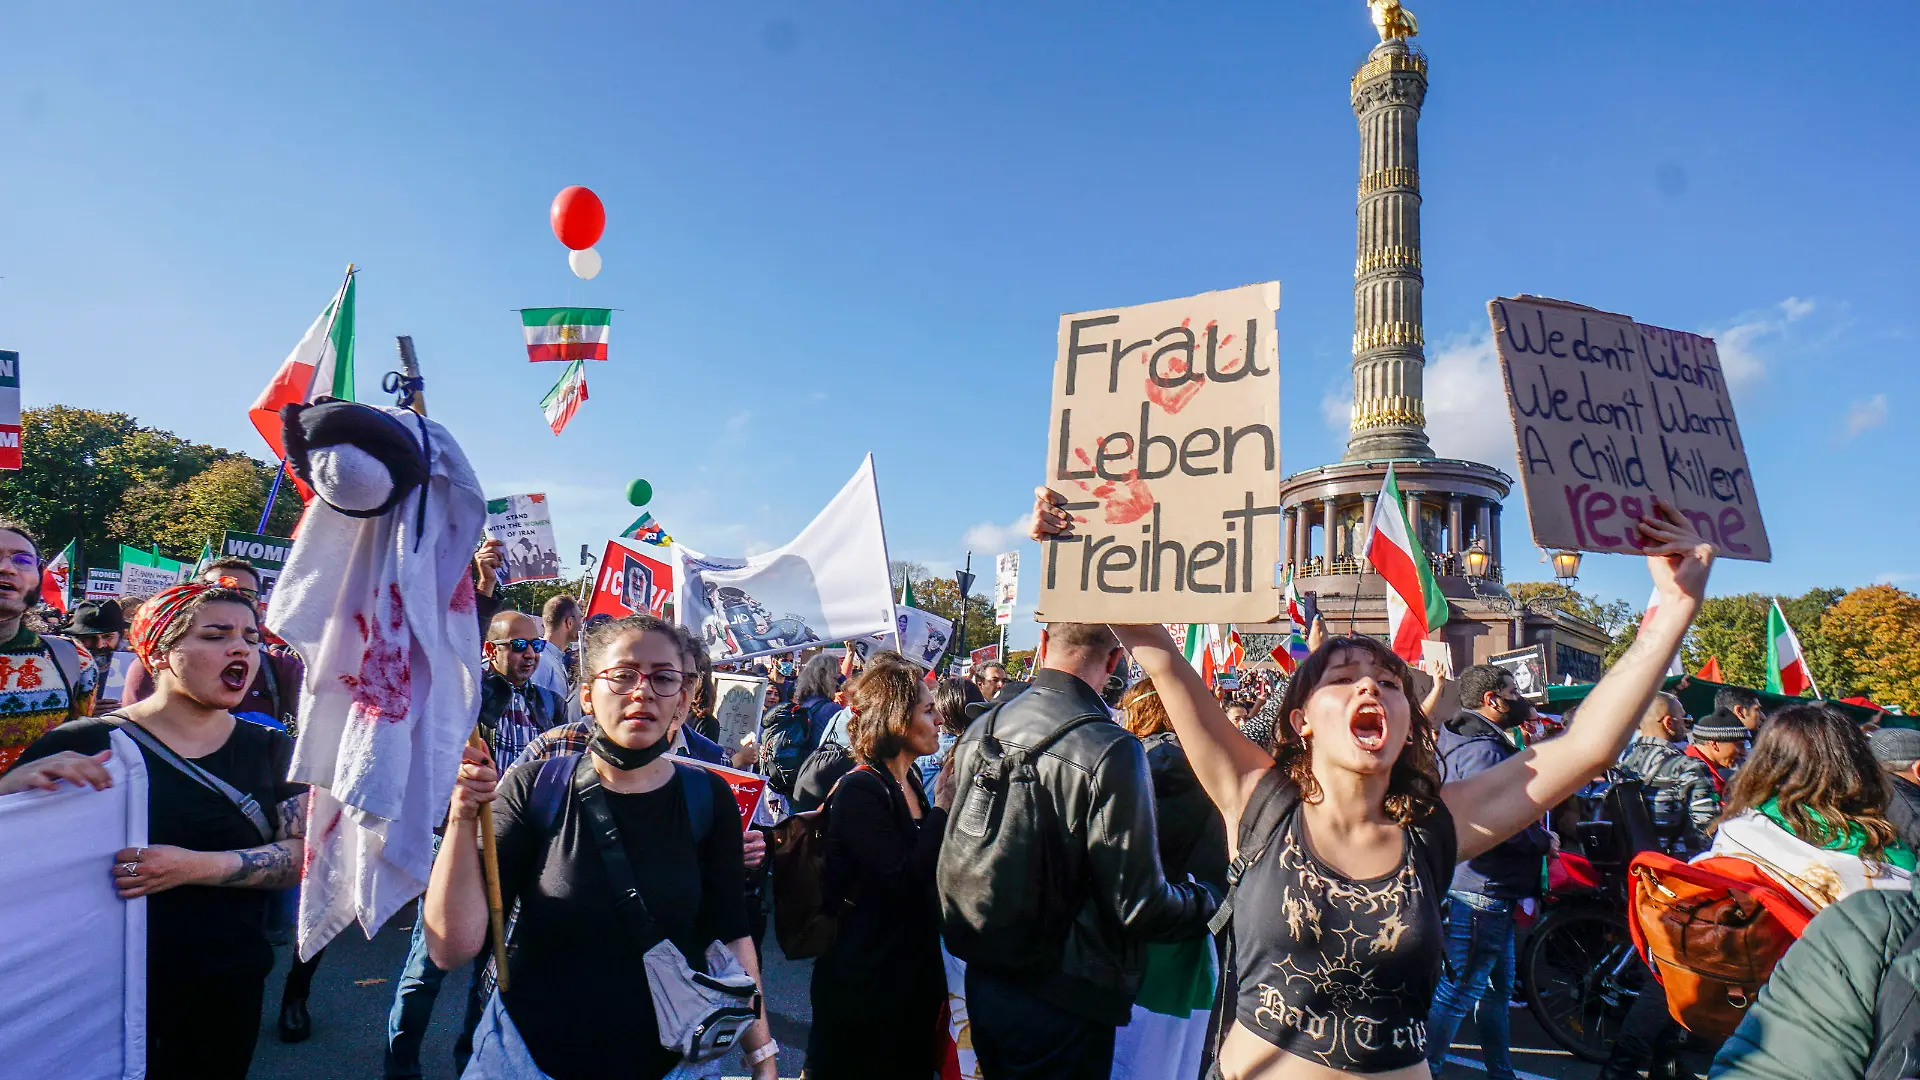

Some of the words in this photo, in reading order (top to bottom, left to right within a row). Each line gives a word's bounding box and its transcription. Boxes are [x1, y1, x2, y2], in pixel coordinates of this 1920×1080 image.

[1066, 315, 1270, 396] Frau
[1500, 300, 1567, 357] We
[1641, 334, 1719, 394] Want
[1506, 359, 1573, 421] We
[1651, 381, 1736, 450] Want
[1057, 401, 1275, 481] Leben
[1524, 425, 1555, 475] A
[488, 524, 506, 532] WITH
[523, 519, 551, 527] WOMEN
[505, 513, 528, 521] STAND
[1046, 491, 1280, 593] Freiheit
[90, 570, 121, 579] WOMEN
[94, 582, 115, 591] LIFE
[1254, 983, 1329, 1040] Bad
